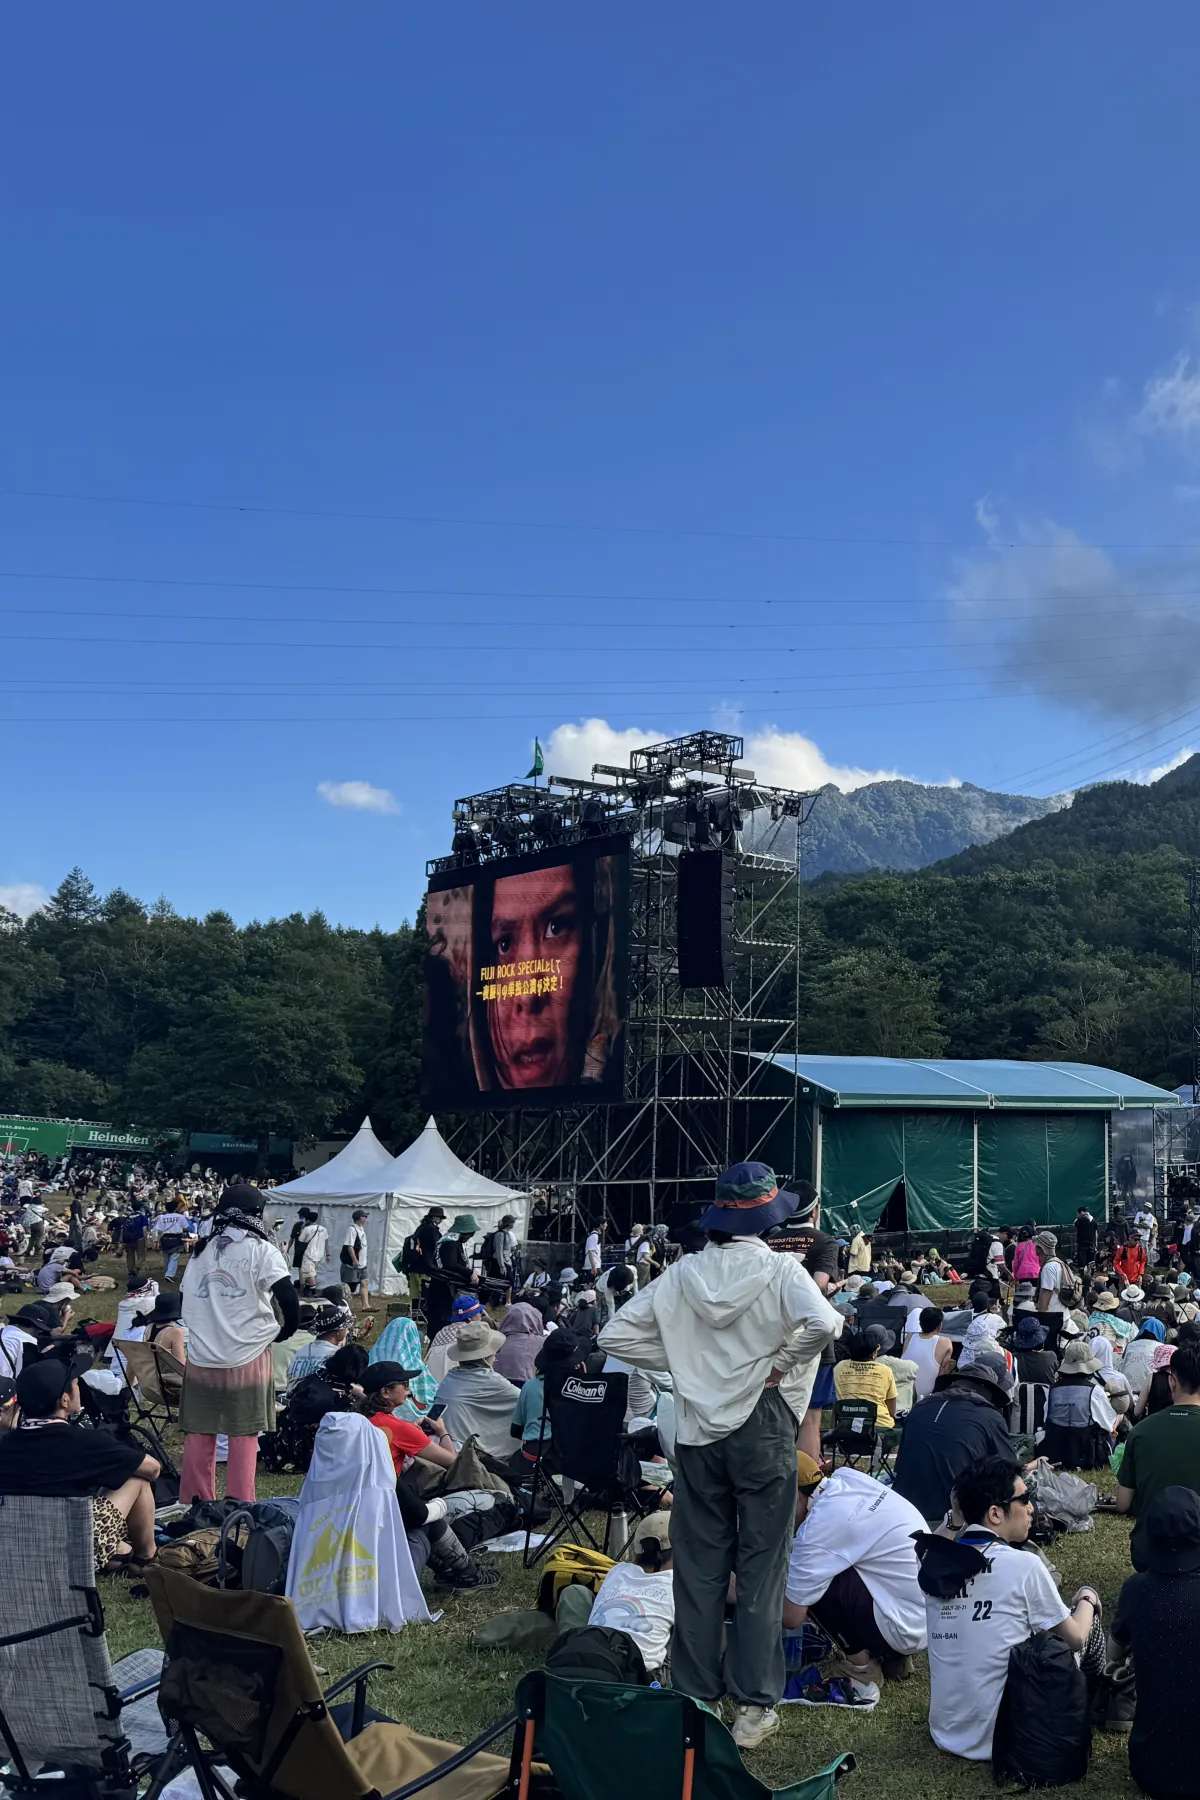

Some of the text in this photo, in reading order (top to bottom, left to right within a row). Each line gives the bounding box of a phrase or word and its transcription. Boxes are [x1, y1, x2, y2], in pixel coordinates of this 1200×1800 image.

[480, 966, 495, 981] FUJI
[496, 963, 516, 979] ROCK
[88, 1130, 149, 1145] Heineken
[162, 1216, 180, 1224] STAFF
